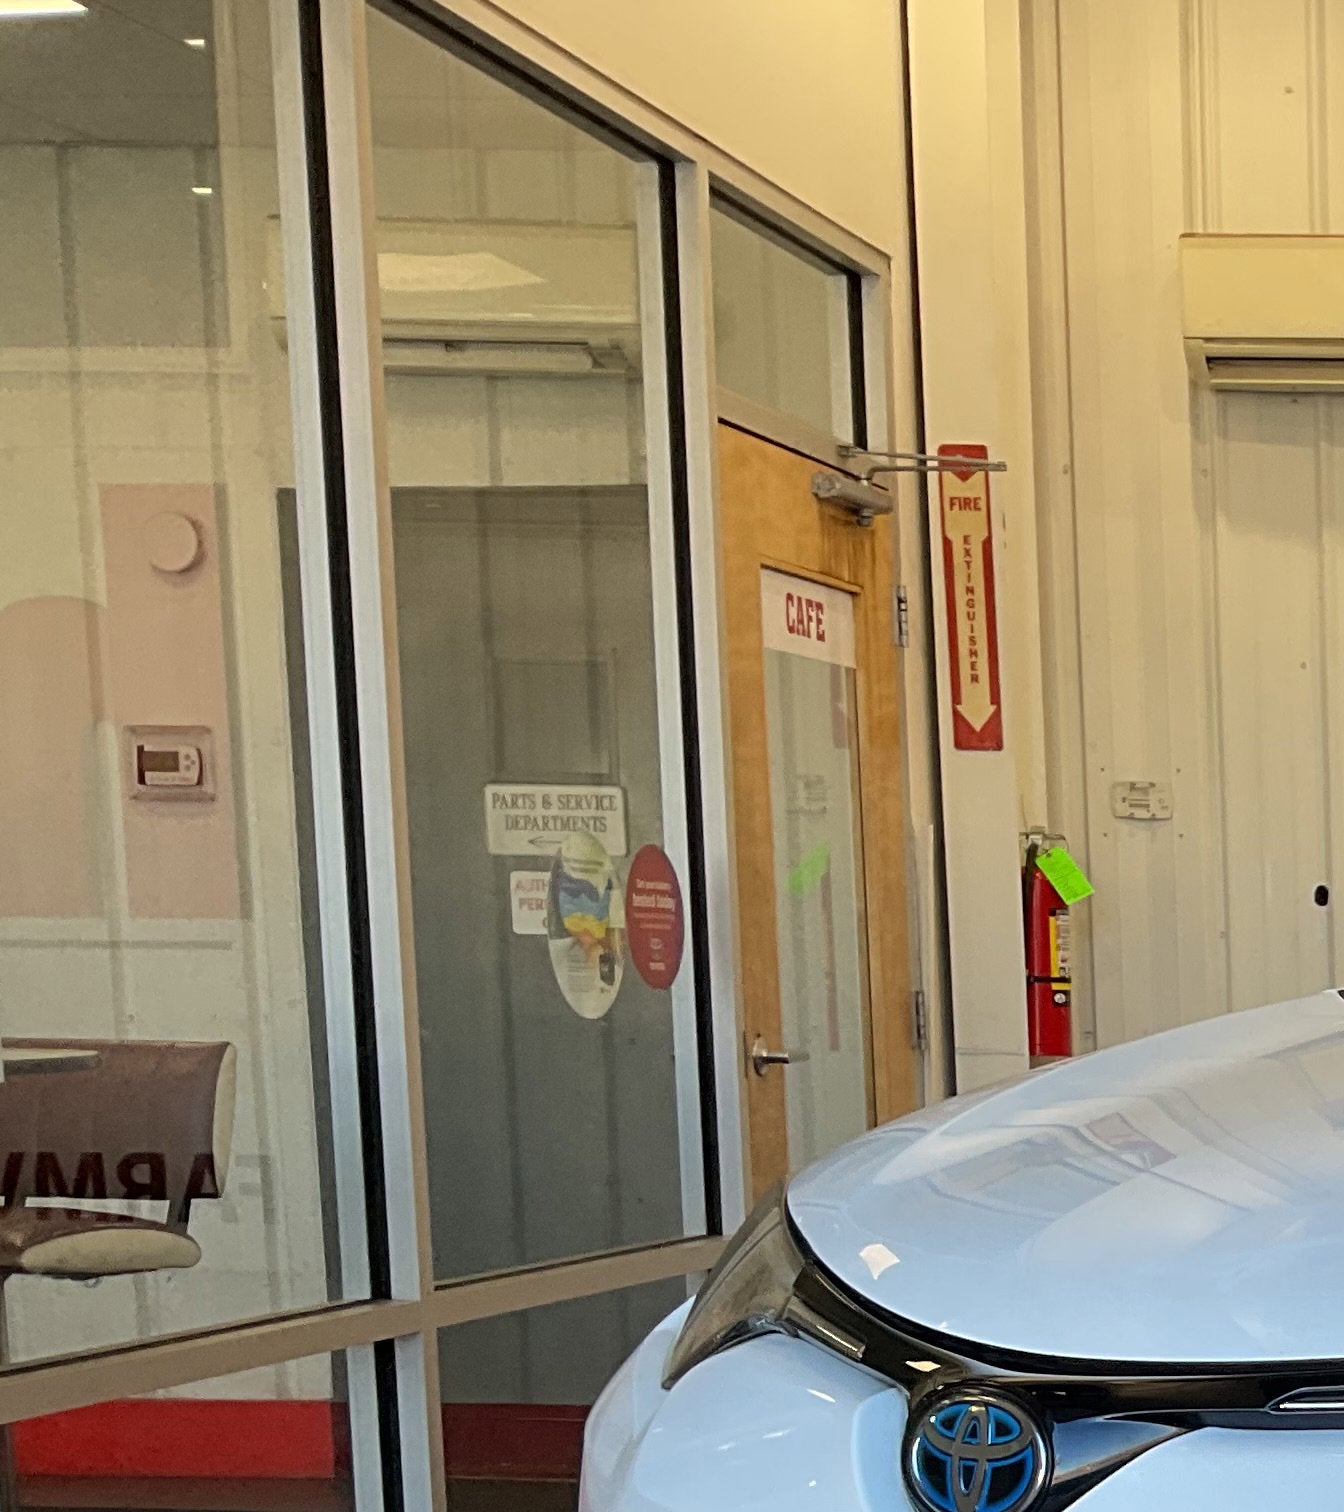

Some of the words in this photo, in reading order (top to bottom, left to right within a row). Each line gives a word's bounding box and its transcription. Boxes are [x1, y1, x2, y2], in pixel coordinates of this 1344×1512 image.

[949, 497, 981, 512] FIRE
[785, 592, 826, 643] CAFE
[963, 535, 980, 683] EXTINGUISHER
[491, 793, 536, 810] PARTS
[541, 793, 553, 810] &
[557, 793, 618, 812] SERVICE
[505, 816, 607, 833] DEPARTMENTS
